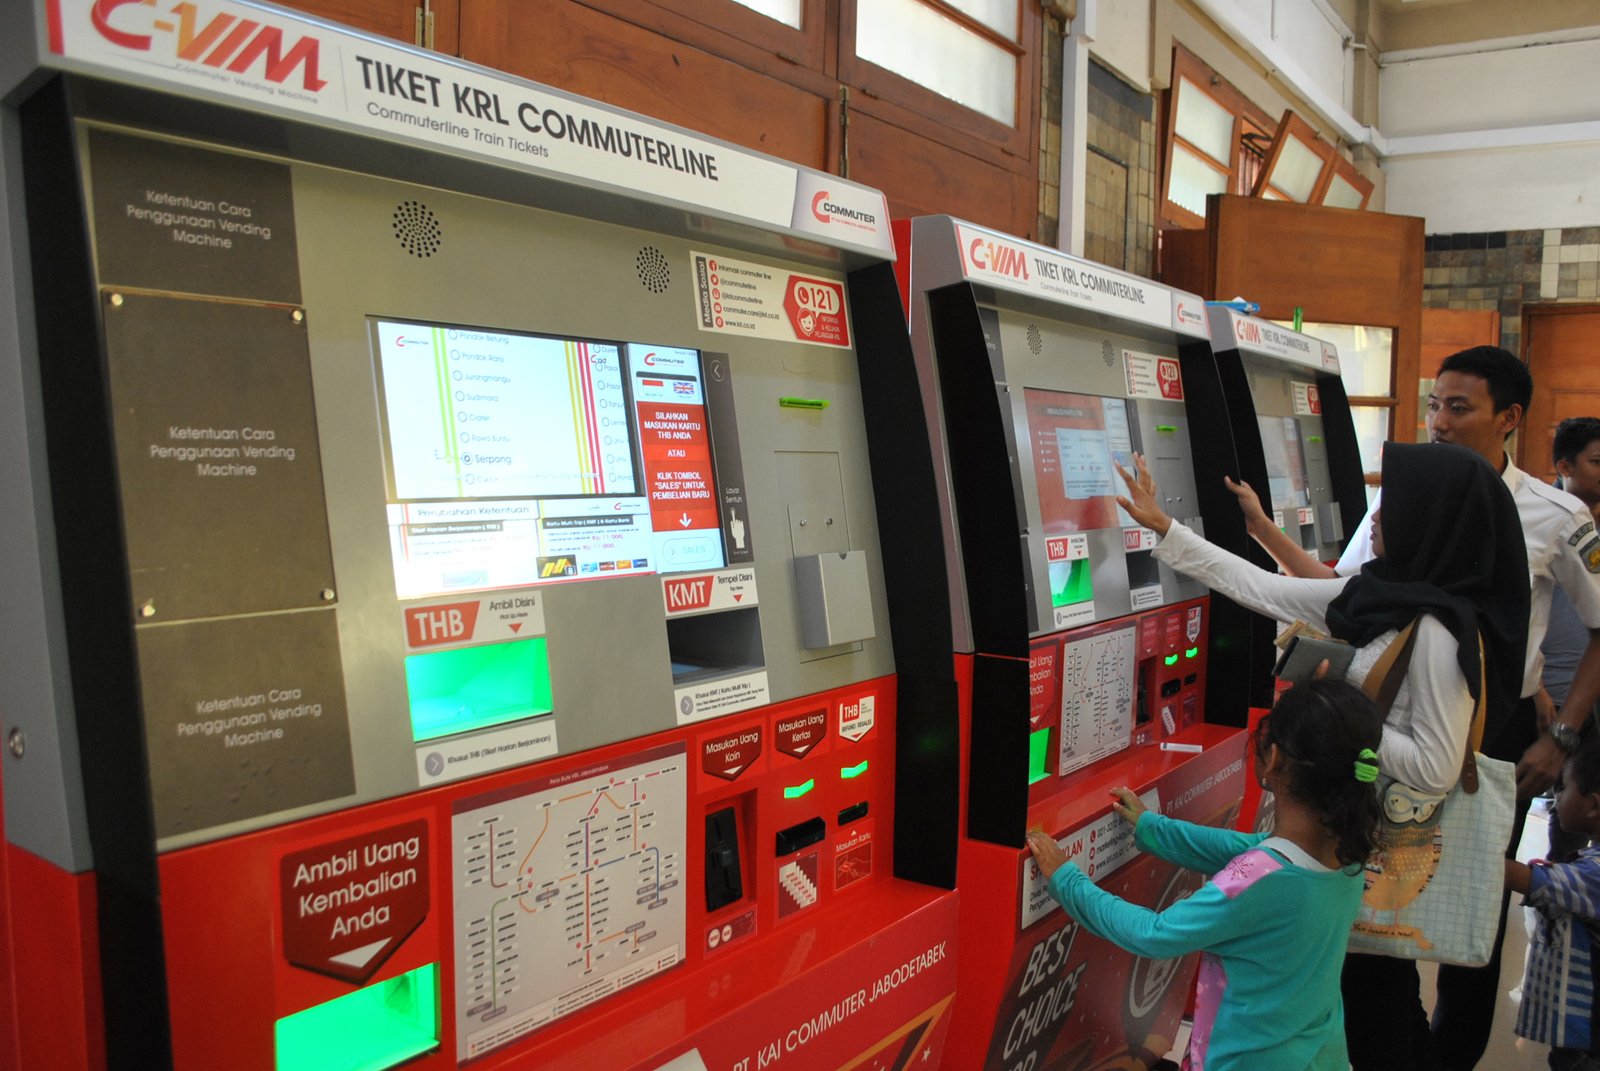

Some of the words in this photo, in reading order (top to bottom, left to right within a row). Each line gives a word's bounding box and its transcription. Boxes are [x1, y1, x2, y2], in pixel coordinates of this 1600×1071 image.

[175, 62, 230, 83] Commuter
[234, 77, 275, 95] Vending
[277, 86, 319, 104] Machine
[355, 55, 441, 108] TIKET
[452, 82, 510, 126] KRL
[517, 102, 719, 182] COMMUTERLINE
[366, 101, 470, 138] Commuterline
[474, 128, 504, 147] Train
[508, 136, 549, 158] Tickets
[146, 189, 215, 212] Ketentuan
[218, 201, 252, 217] Cara
[823, 202, 876, 224] COMMUTER
[126, 204, 216, 229] Penggunaan
[218, 217, 272, 240] Vending
[173, 229, 232, 248] Machine
[698, 261, 707, 289] Sosial
[1034, 258, 1060, 281] TIKET
[1060, 265, 1080, 286] KRL
[1080, 271, 1146, 304] COMMUTERLINE
[702, 291, 712, 323] Media
[810, 287, 833, 311] 121
[644, 421, 678, 430] MASUKAN
[678, 422, 701, 431] KARTU
[655, 411, 689, 421] SILAHKAN
[169, 426, 239, 440] Ketentuan
[242, 427, 275, 441] Cara
[657, 431, 672, 440] THB
[673, 432, 692, 440] ANDA
[150, 444, 240, 461] Penggunaan
[242, 445, 296, 461] Vending
[474, 454, 512, 465] Serpong
[667, 449, 686, 458] ATAU
[197, 464, 257, 477] Machine
[657, 472, 673, 480] KLIK
[674, 471, 702, 480] TOMBOL
[653, 490, 692, 500] PEMBELIAN
[691, 489, 710, 499] BARU
[654, 481, 682, 490] "SALES"
[682, 480, 706, 489] UNTUK
[725, 487, 740, 495] Layar
[418, 508, 477, 517] Perubahan
[479, 506, 530, 515] Ketentuan
[1049, 540, 1065, 559] THB
[717, 575, 738, 585] Tempel
[739, 572, 753, 582] Disini
[490, 600, 514, 611] Ambil
[515, 597, 536, 608] Disini
[668, 581, 706, 608] KMT
[414, 609, 465, 641] THB
[197, 693, 265, 714] Ketentuan
[268, 688, 301, 702] Cara
[1029, 685, 1044, 696] nda
[177, 712, 266, 736] Penggunaan
[269, 703, 322, 721] Vending
[844, 704, 859, 719] THB
[778, 718, 807, 734] Masukan
[808, 713, 825, 726] Uang
[224, 727, 284, 748] Machine
[706, 736, 739, 755] Masukan
[739, 731, 759, 746] Uang
[792, 730, 811, 743] Kertas
[725, 751, 741, 764] Koin
[836, 837, 858, 852] Masukan
[1062, 838, 1083, 859] KLAN
[293, 849, 358, 888] Ambil
[364, 837, 420, 867] Uang
[300, 868, 417, 918] Kembalian
[330, 905, 390, 940] Anda
[1018, 921, 1079, 998] BEST
[757, 1038, 781, 1071] KAI
[785, 989, 866, 1052] COMMUTER
[869, 941, 946, 1003] JABODETABEK
[1003, 960, 1088, 1061] CHOICE
